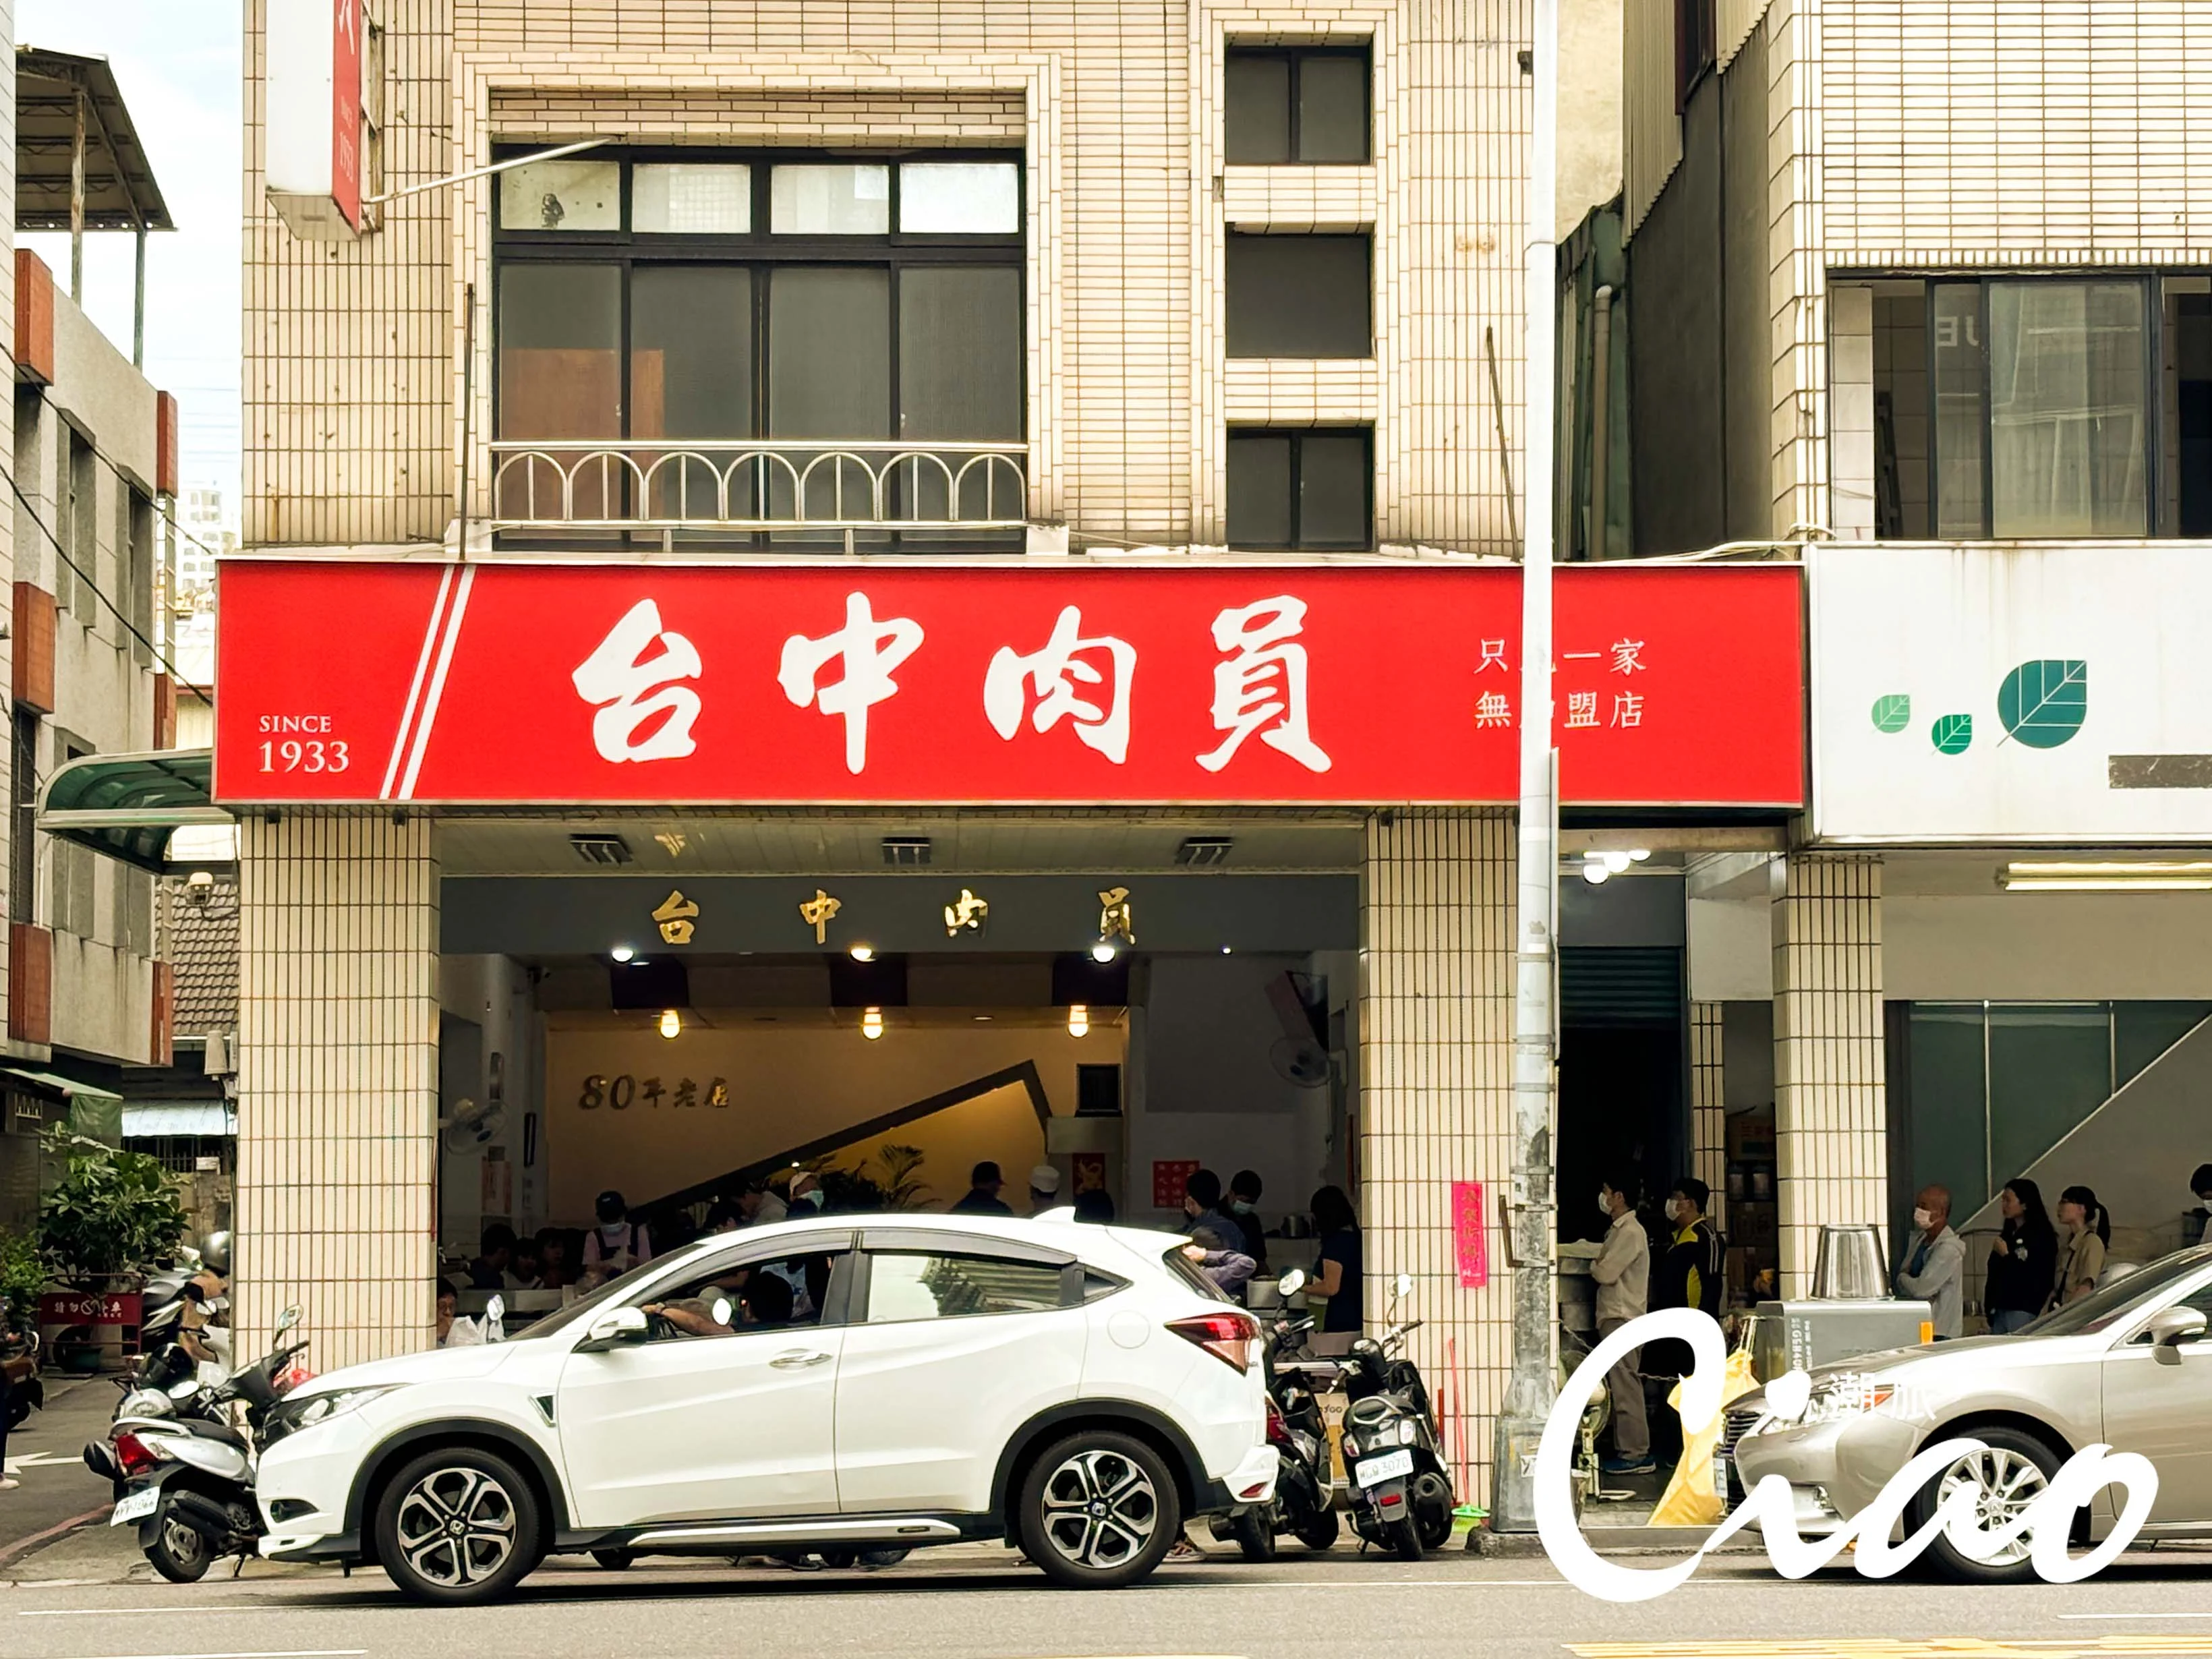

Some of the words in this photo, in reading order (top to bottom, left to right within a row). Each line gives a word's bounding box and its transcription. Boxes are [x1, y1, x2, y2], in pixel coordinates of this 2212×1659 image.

[1474, 638, 1646, 675] 只一家
[572, 591, 1331, 776] 台中肉員
[259, 716, 331, 733] SINCE
[1475, 691, 1645, 729] 無盟店
[259, 740, 349, 773] 1933
